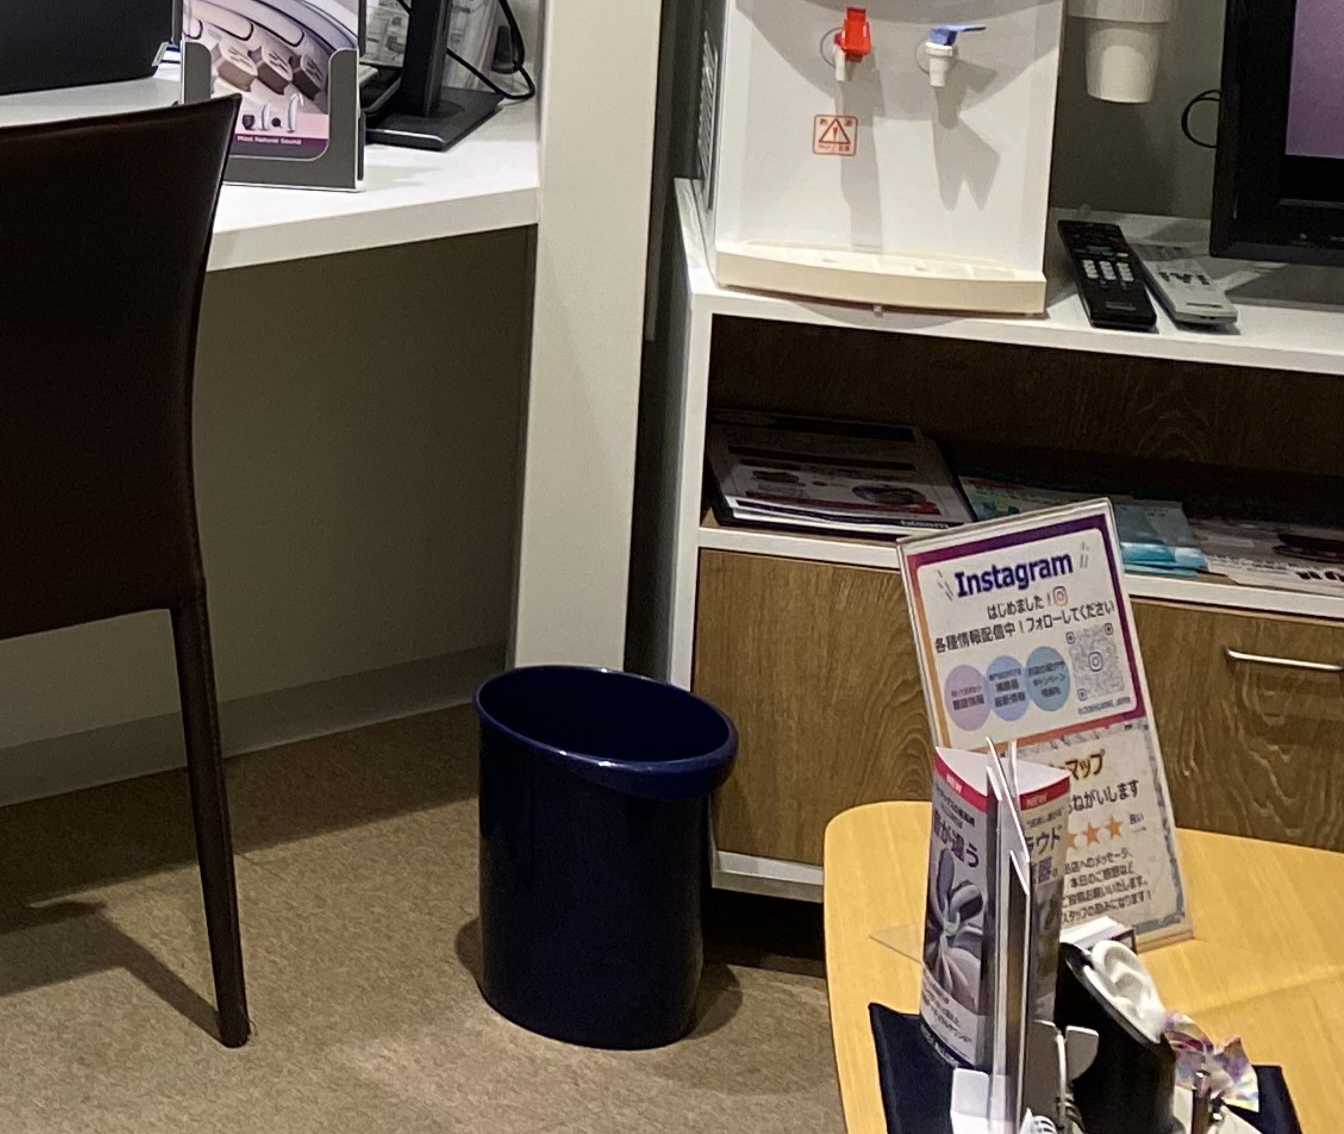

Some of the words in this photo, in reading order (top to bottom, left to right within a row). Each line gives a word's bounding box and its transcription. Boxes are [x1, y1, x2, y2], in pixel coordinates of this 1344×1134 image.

[954, 553, 1074, 598] Instagram
[1064, 749, 1106, 780] マップ
